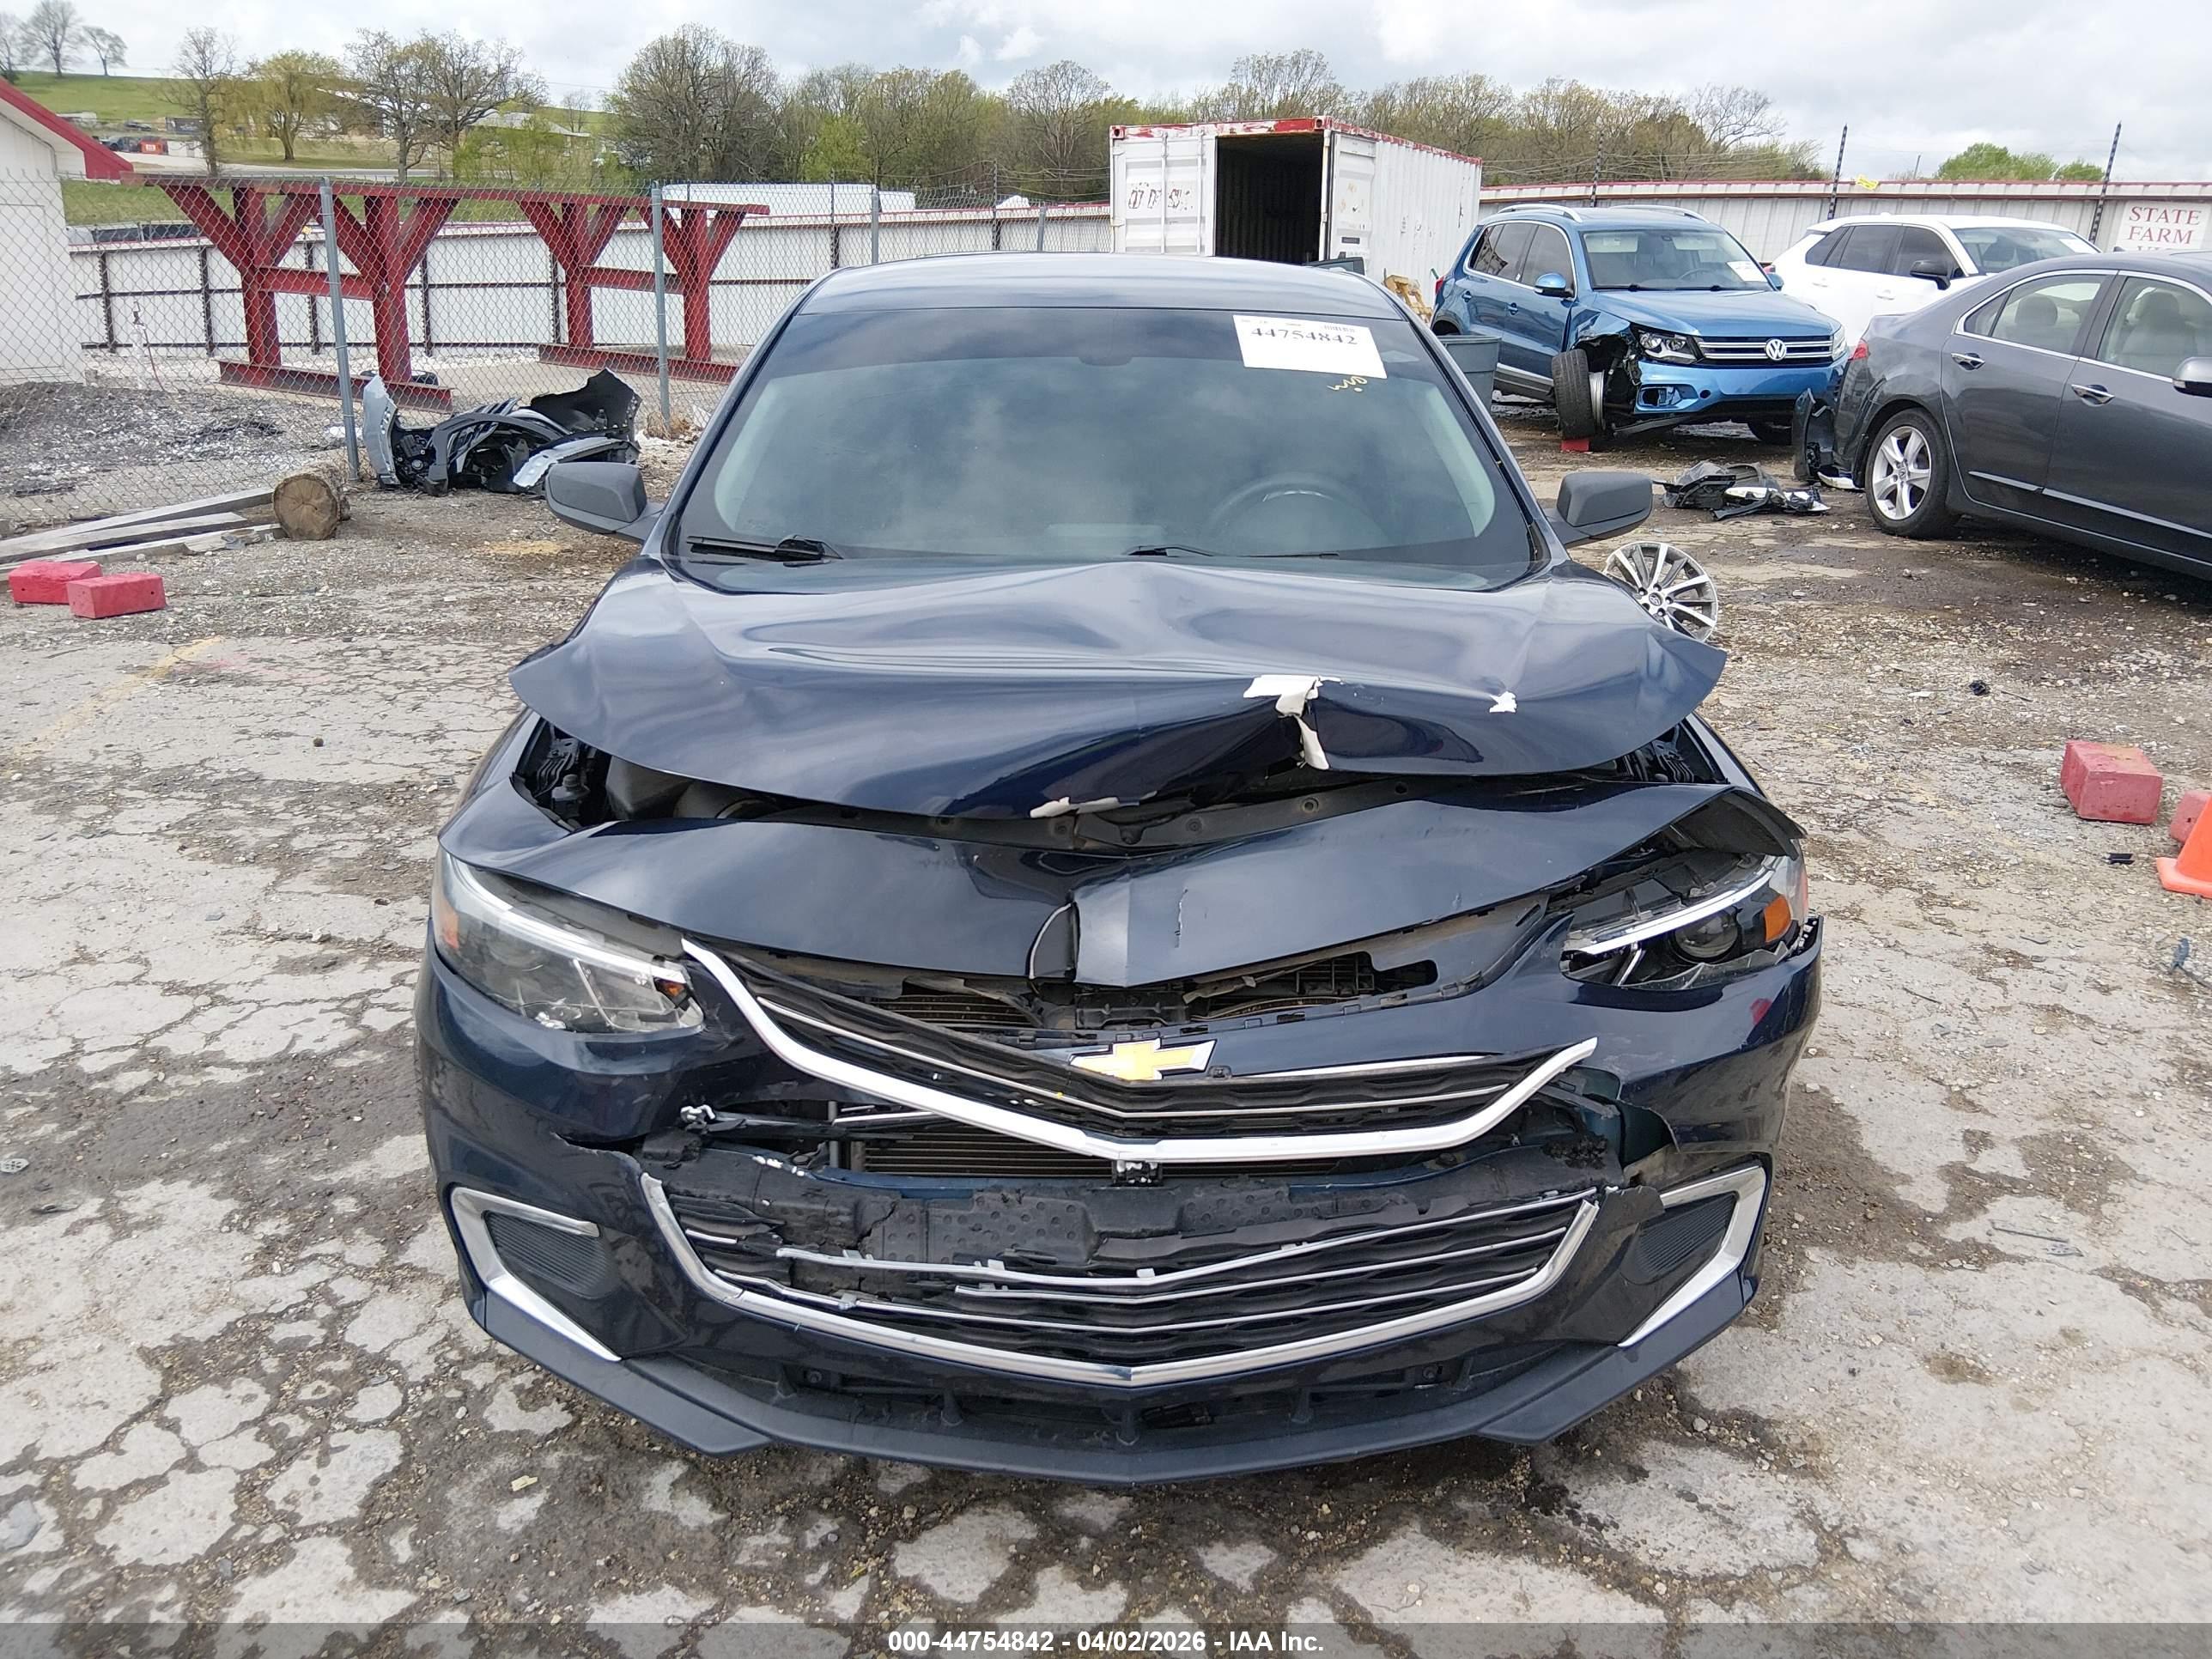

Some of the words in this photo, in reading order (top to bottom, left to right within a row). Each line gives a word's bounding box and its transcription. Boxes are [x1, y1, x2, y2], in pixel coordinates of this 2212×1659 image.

[2129, 206, 2202, 225] STATE
[2127, 226, 2194, 245] FARM
[1250, 327, 1358, 345] 44754842
